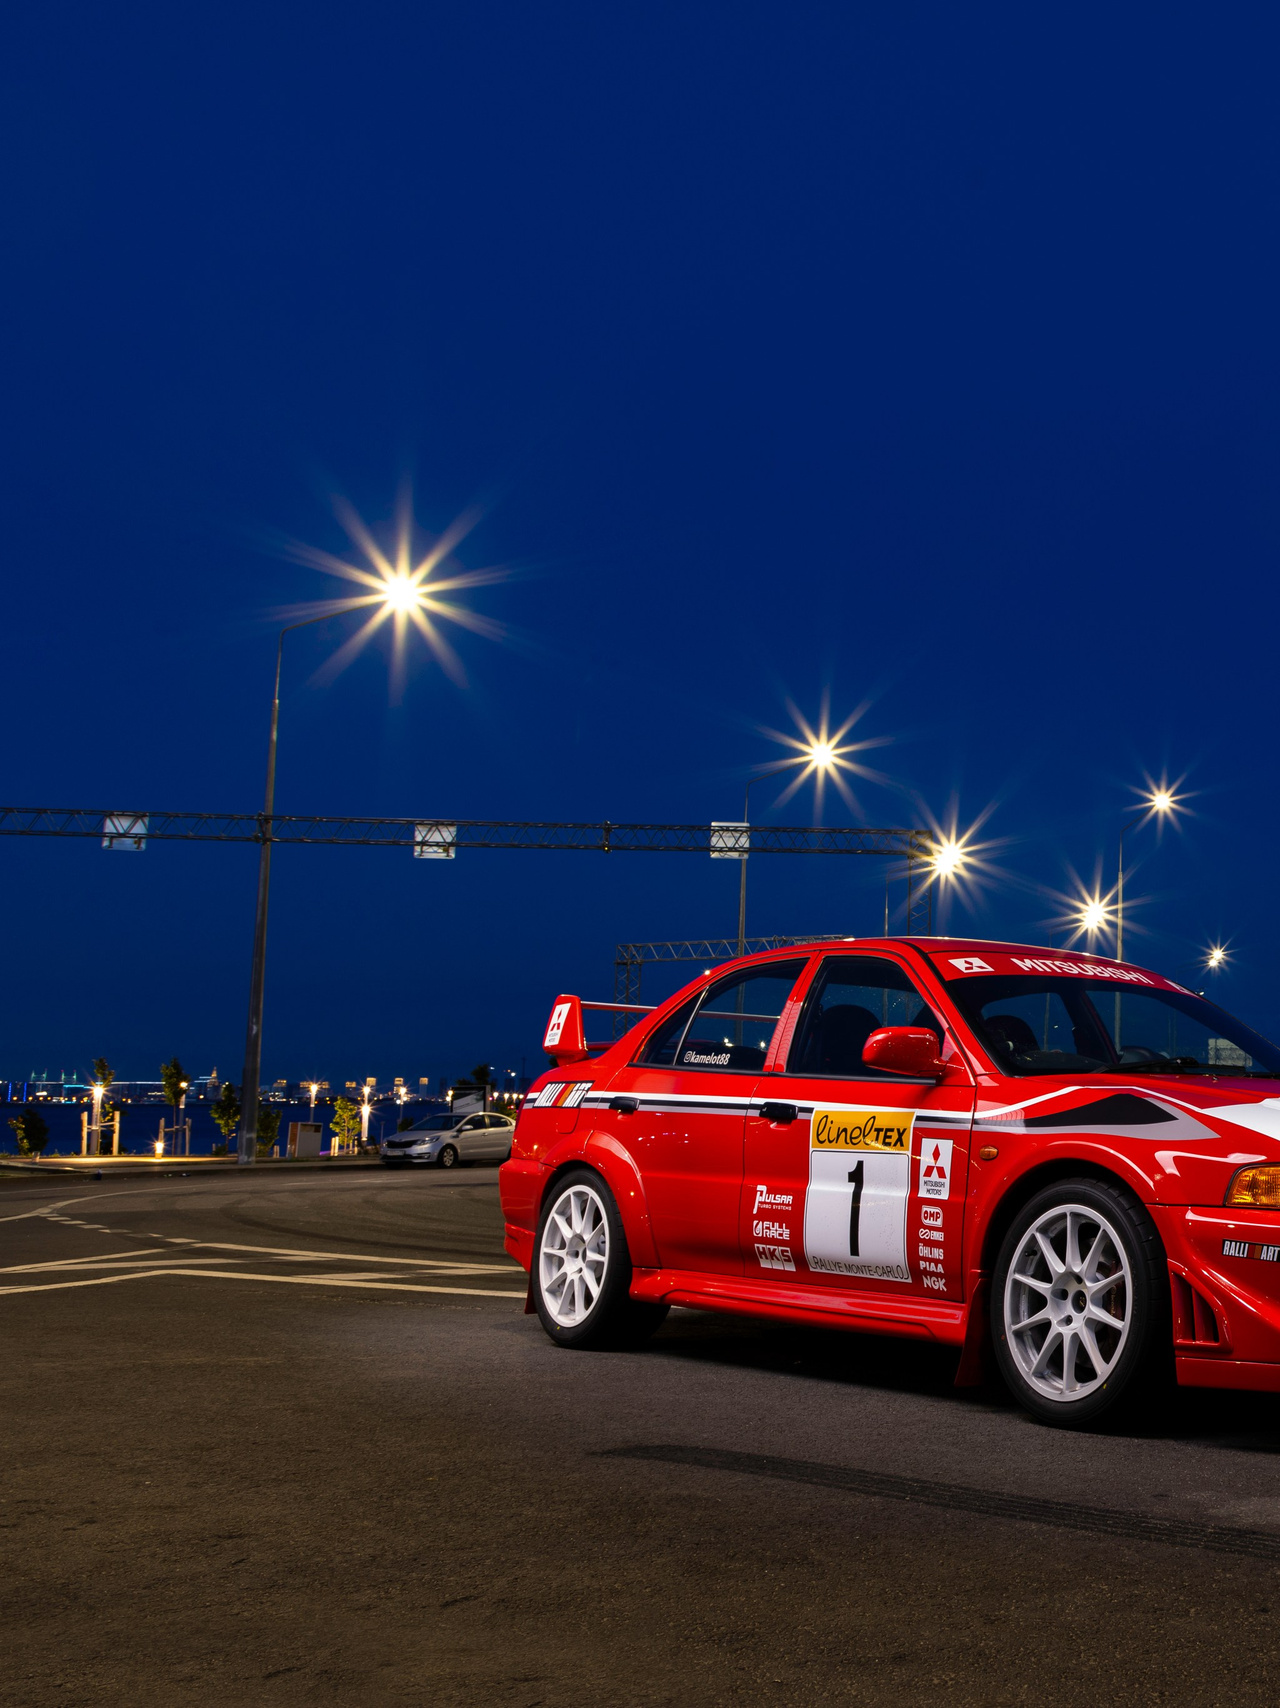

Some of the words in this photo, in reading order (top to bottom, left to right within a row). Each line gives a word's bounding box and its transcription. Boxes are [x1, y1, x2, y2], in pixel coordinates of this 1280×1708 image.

[1010, 958, 1154, 985] MITSUBISHI
[683, 1050, 731, 1066] @kamelot88
[753, 1184, 793, 1215] PULSAR
[848, 1160, 864, 1257] 1
[923, 1209, 941, 1222] OMP
[763, 1221, 790, 1232] FULL
[763, 1229, 790, 1240] RACE
[757, 1245, 793, 1263] HKS
[918, 1243, 944, 1260] ÖHLINS
[1223, 1240, 1249, 1258] RALLI
[1260, 1245, 1280, 1262] ART
[812, 1255, 843, 1273] RALLYE
[843, 1264, 904, 1280] MONTE-CARLO
[919, 1260, 945, 1274] PIAA
[922, 1275, 947, 1292] NGK
